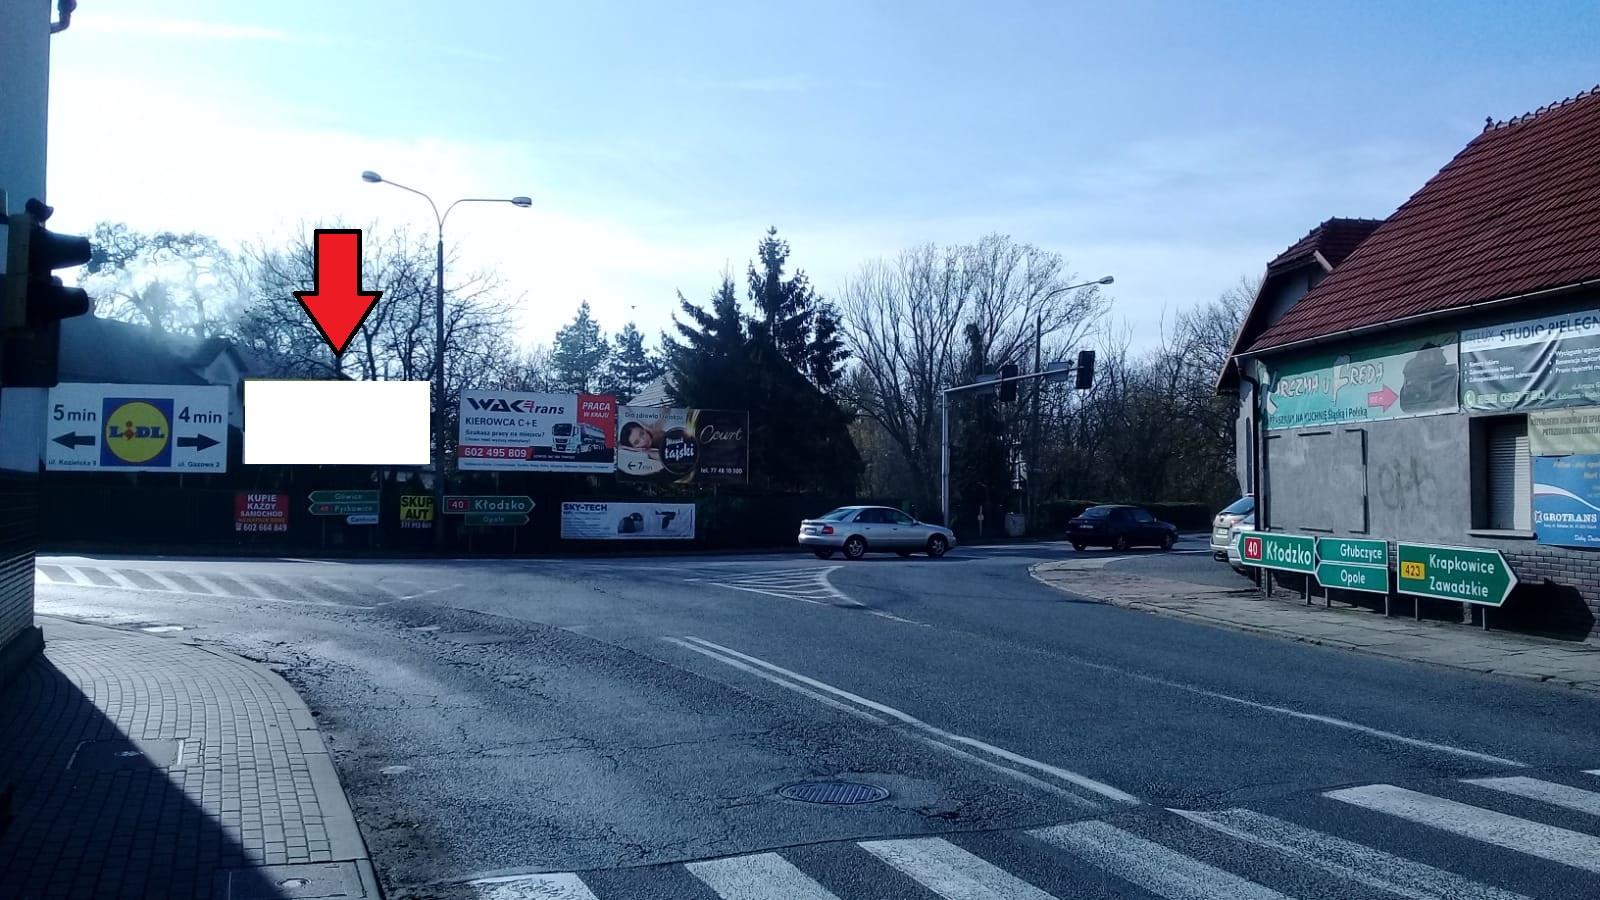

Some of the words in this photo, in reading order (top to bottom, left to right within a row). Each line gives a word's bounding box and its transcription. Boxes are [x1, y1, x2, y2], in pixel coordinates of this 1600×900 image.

[1500, 325, 1544, 341] STUDIO
[54, 404, 64, 420] 5
[68, 408, 96, 421] min
[582, 402, 610, 410] PRACA
[179, 407, 190, 422] 4
[194, 411, 222, 423] min
[465, 417, 516, 427] KIEROWCA
[518, 419, 537, 427] C+E
[1296, 414, 1304, 422] NA
[1349, 408, 1368, 418] Polską
[465, 448, 482, 456] 602
[486, 448, 505, 456] 495
[508, 449, 527, 457] 809
[665, 443, 694, 461] tajski
[638, 462, 643, 470] 7
[401, 497, 433, 507] SKUP
[475, 500, 525, 510] Kłodzko
[405, 509, 428, 518] AUT
[1543, 513, 1597, 523] GROTRANS
[1247, 541, 1258, 556] 40
[1266, 540, 1311, 565] Kłodzko
[1340, 543, 1383, 561] Głubczyce
[1405, 564, 1421, 577] 423
[1429, 554, 1495, 575] Krapkowice
[1340, 569, 1366, 586] Opole
[1429, 575, 1489, 598] Zawadzkie
